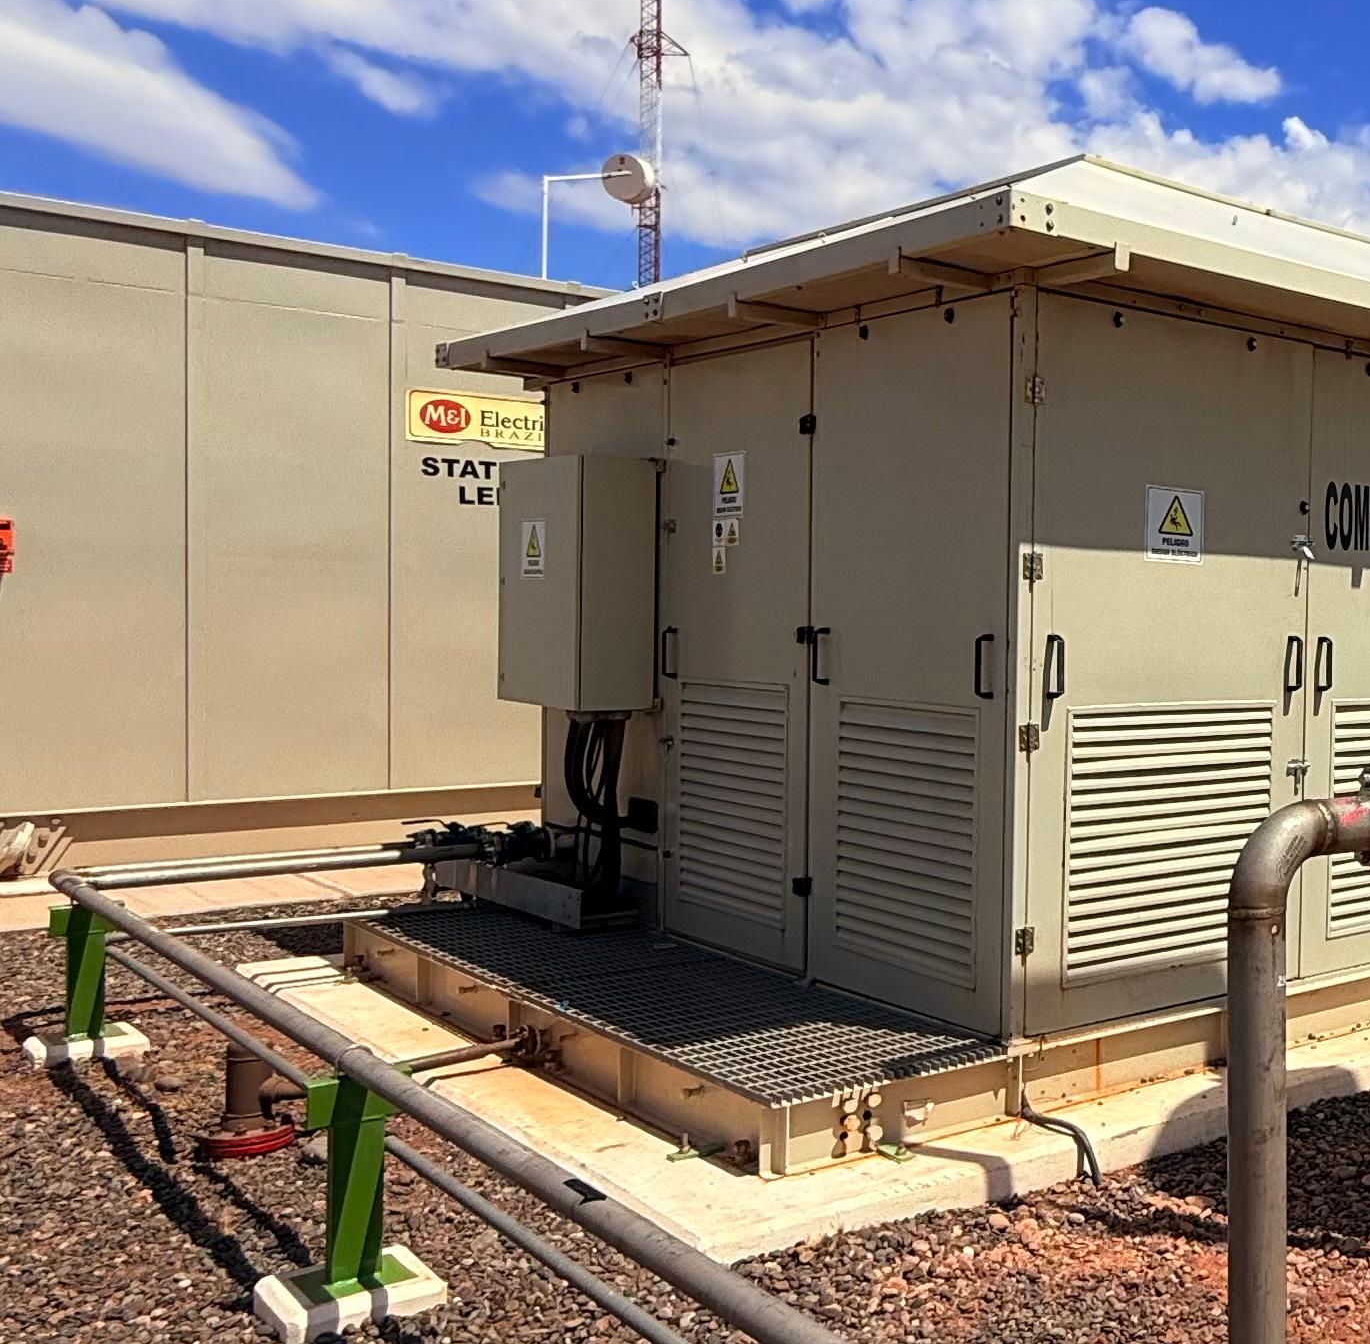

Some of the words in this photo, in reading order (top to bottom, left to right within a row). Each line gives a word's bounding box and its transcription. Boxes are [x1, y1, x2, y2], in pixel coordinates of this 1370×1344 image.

[424, 404, 467, 428] M&I
[480, 410, 544, 431] Electri
[480, 428, 542, 442] BRAZI
[421, 457, 497, 480] STAT
